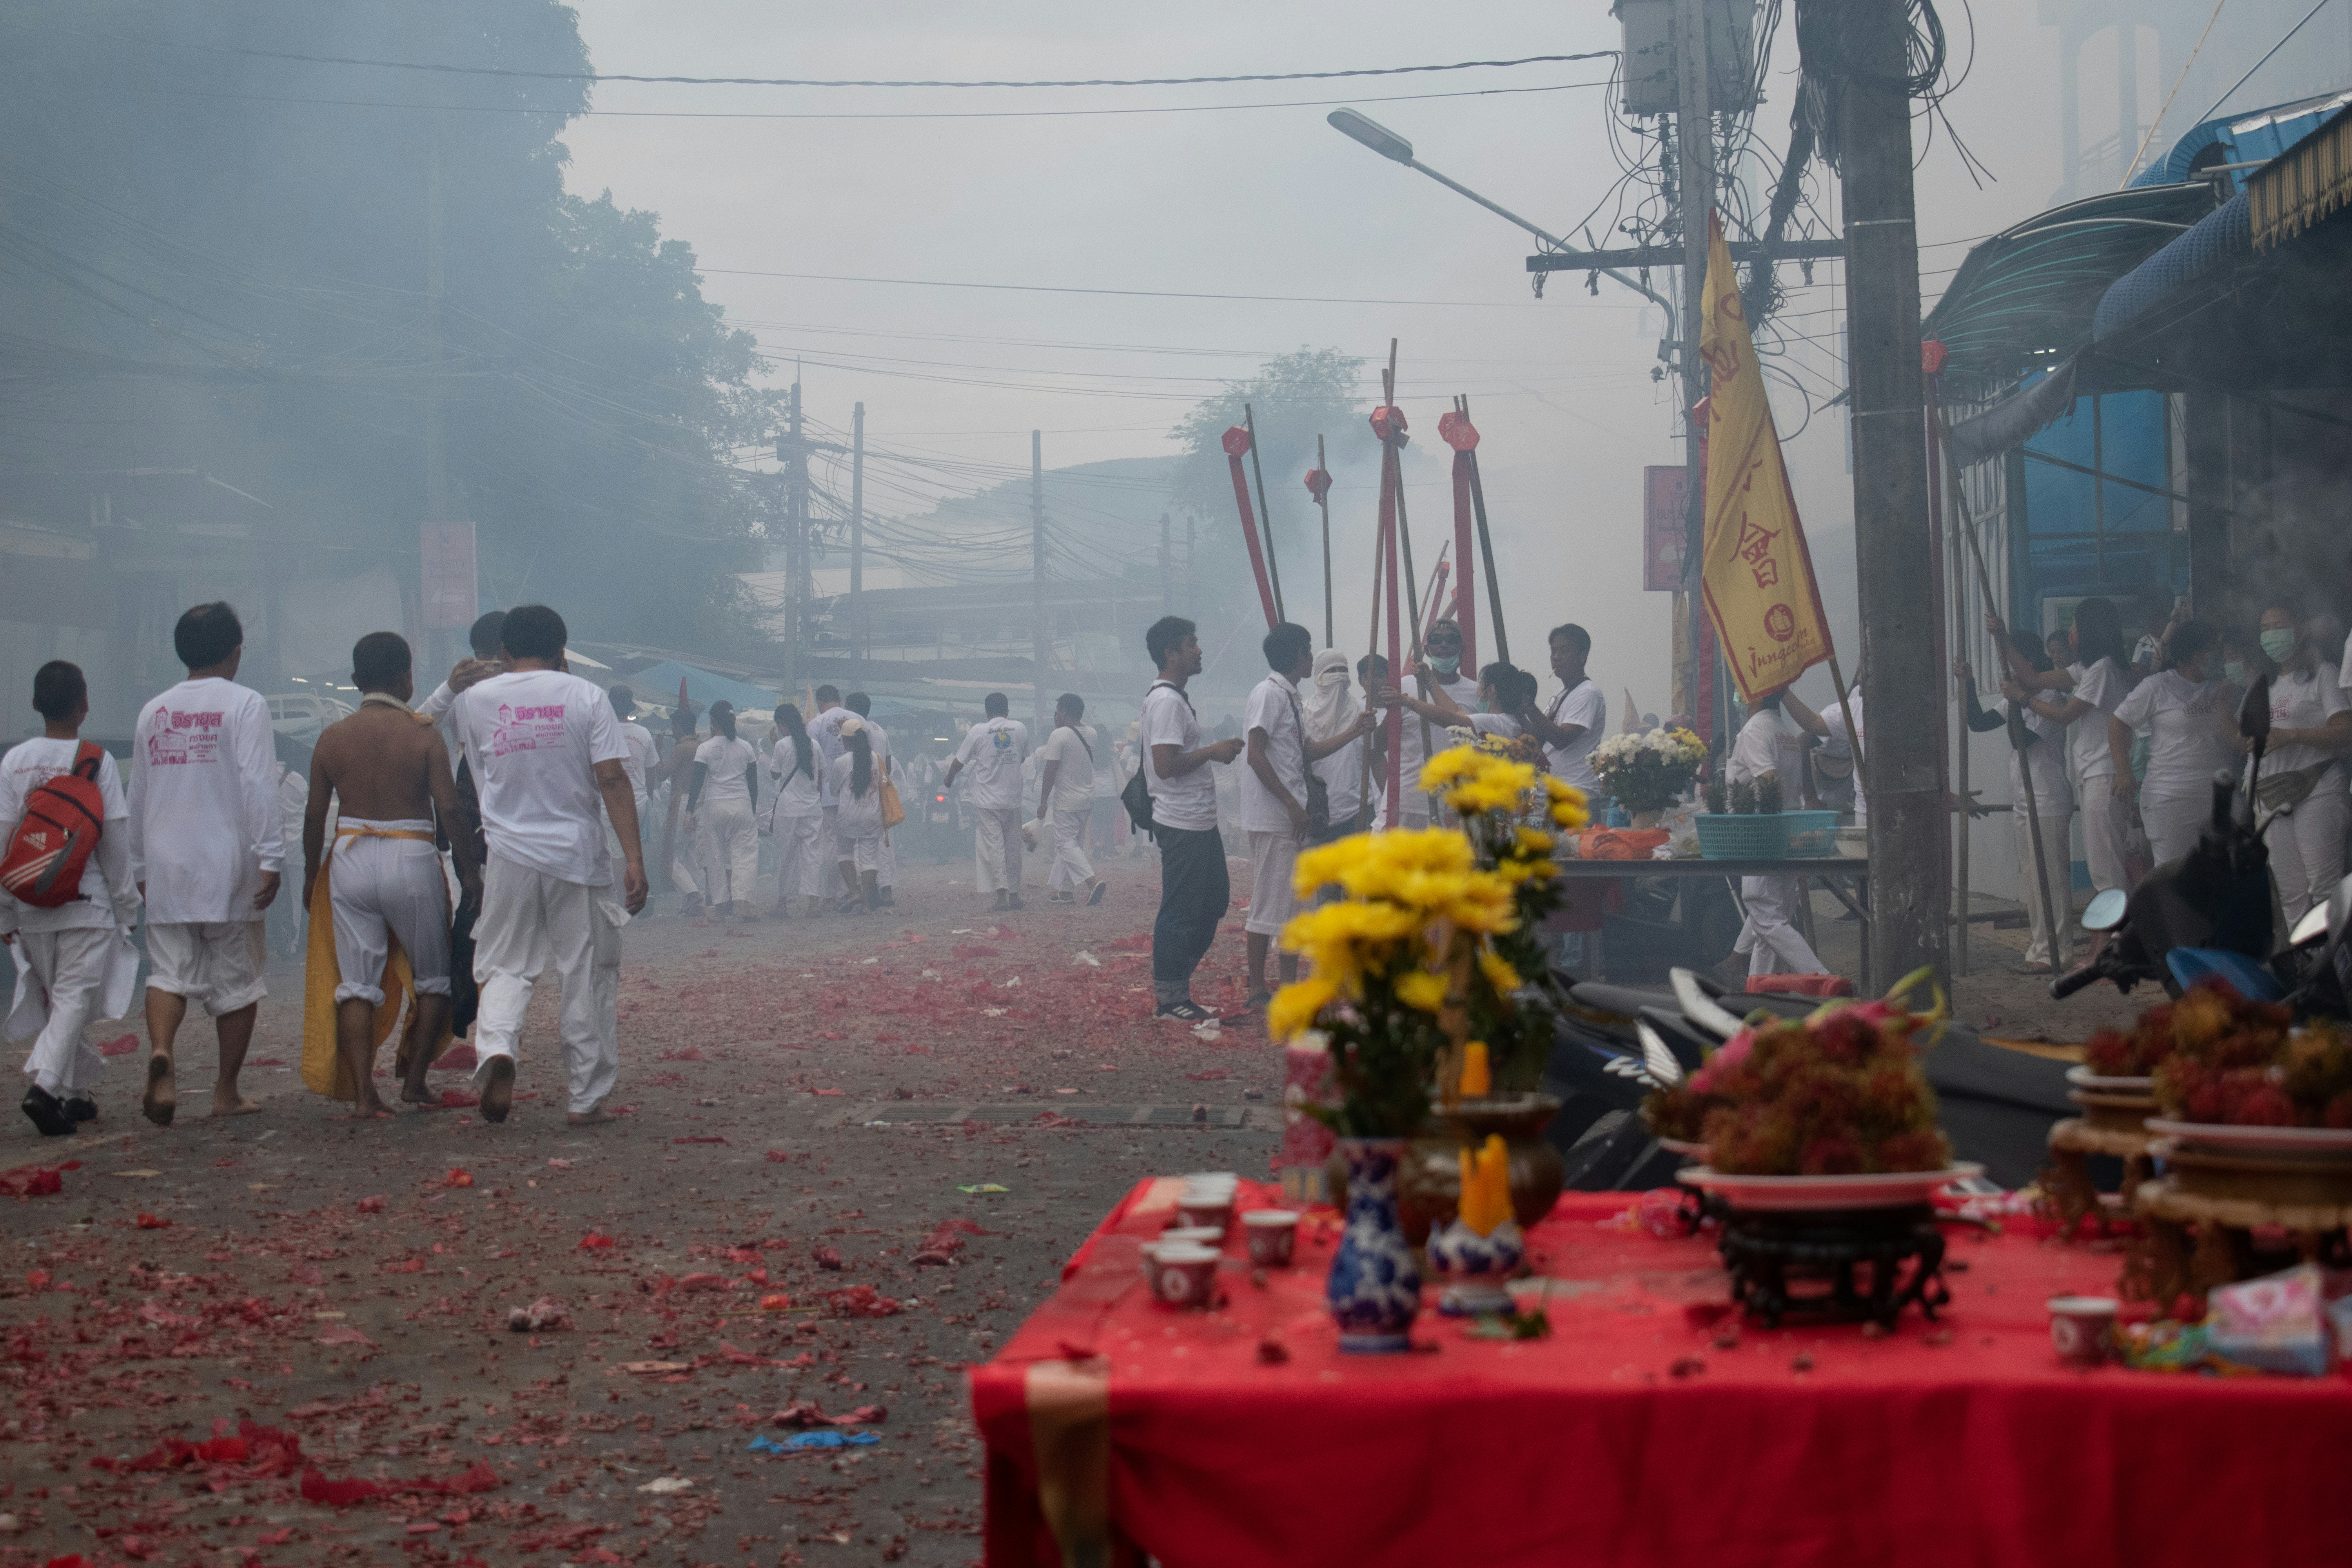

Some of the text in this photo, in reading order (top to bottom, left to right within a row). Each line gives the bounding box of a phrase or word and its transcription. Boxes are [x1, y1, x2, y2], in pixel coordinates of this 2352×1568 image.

[172, 711, 225, 732] จิรายุส
[23, 835, 46, 851] adidas
